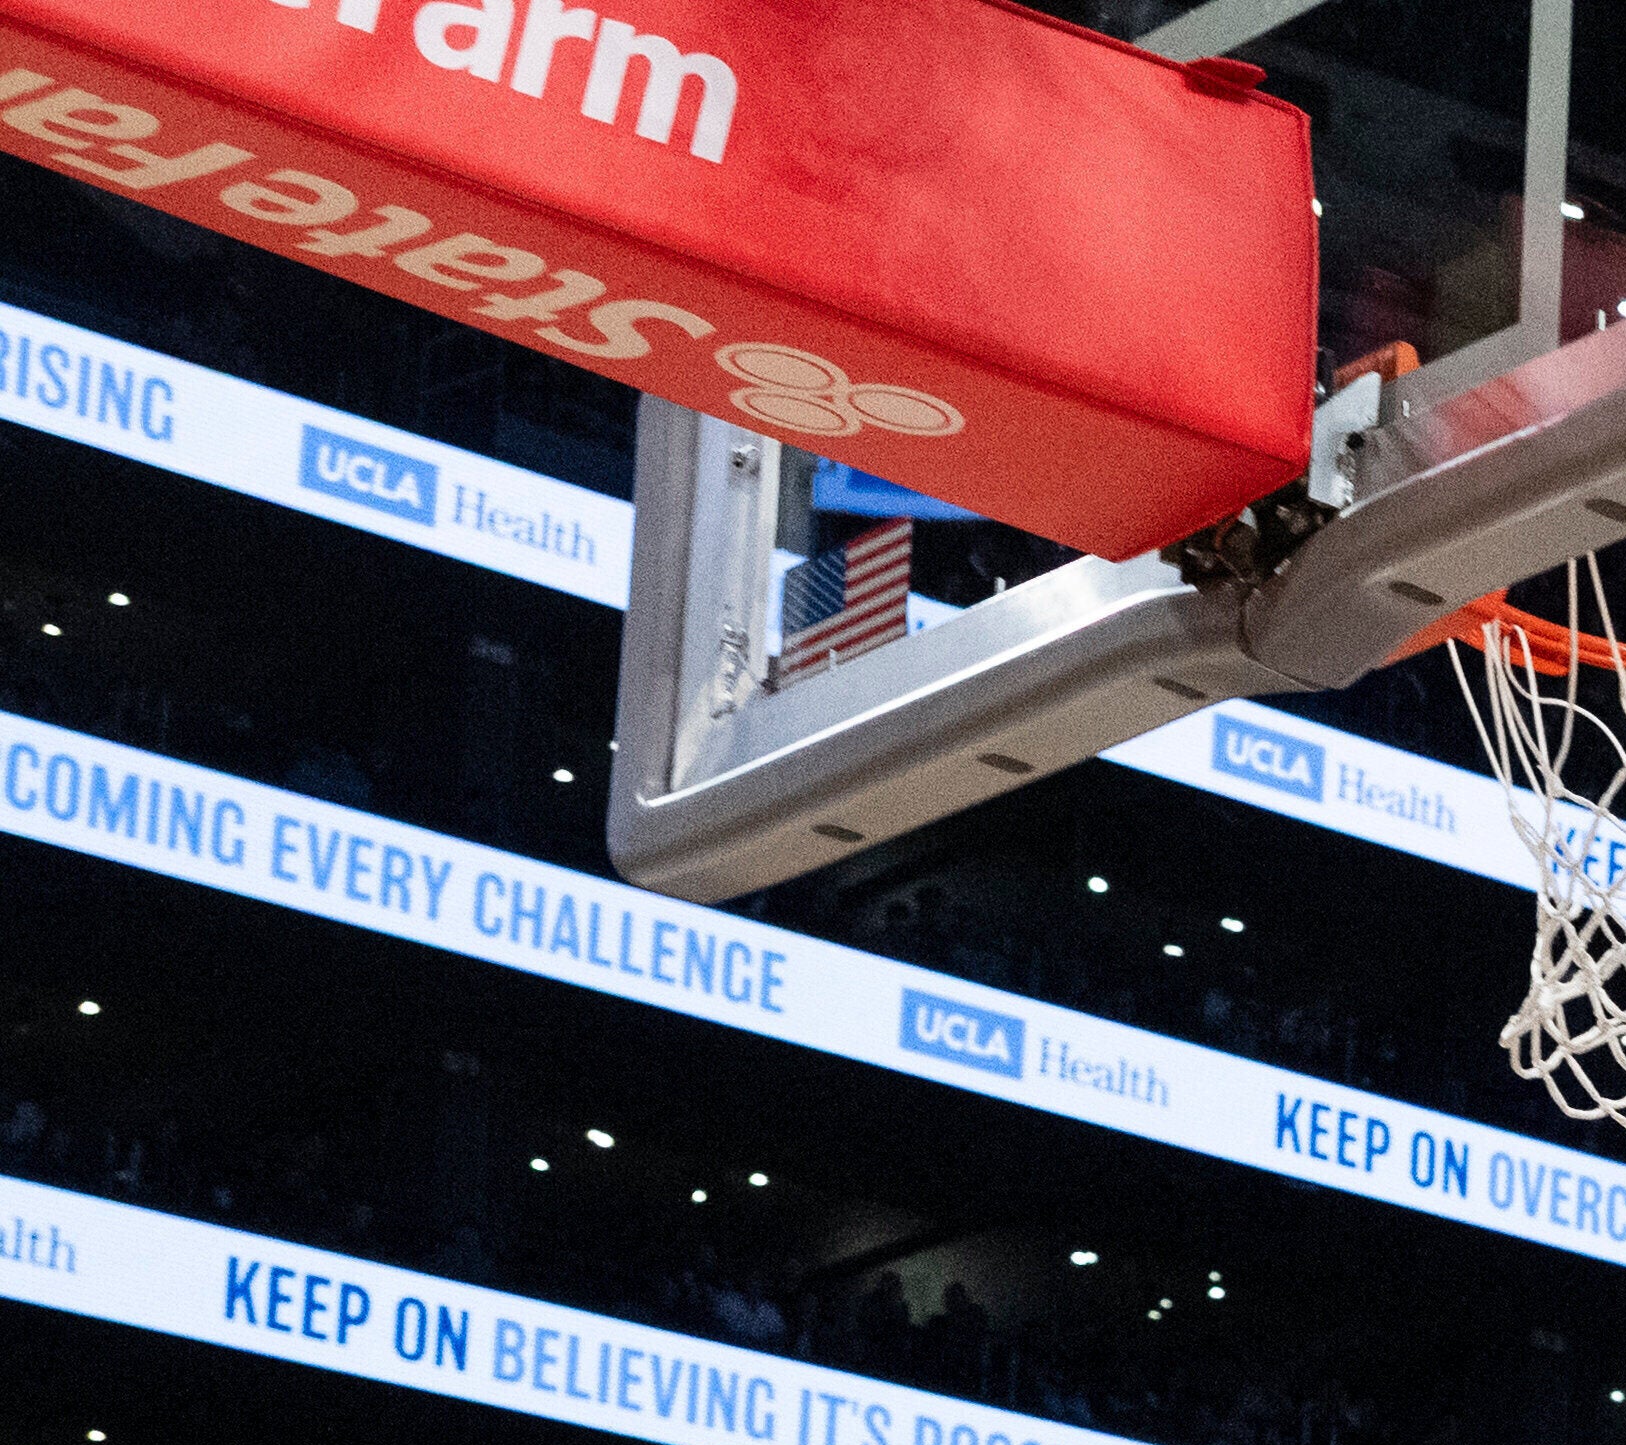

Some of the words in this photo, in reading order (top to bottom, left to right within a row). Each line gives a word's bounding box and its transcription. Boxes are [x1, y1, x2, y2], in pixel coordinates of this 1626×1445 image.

[219, 169, 716, 360] State
[316, 446, 422, 510] UCLA
[453, 484, 596, 566] Health
[1225, 734, 1312, 787] UCLA
[1338, 764, 1457, 834] Health
[2, 741, 247, 868] COMING
[270, 813, 453, 921] EVERY
[472, 871, 787, 1015] CHALLENGE
[912, 1007, 1011, 1063] UCLA
[1039, 1037, 1169, 1107] Health
[1274, 1091, 1393, 1174] KEEP
[1408, 1129, 1471, 1200] ON
[0, 1217, 76, 1274] lth
[222, 1254, 373, 1348] KEEP
[392, 1295, 471, 1374] ON
[492, 1317, 775, 1441] BELIEVING
